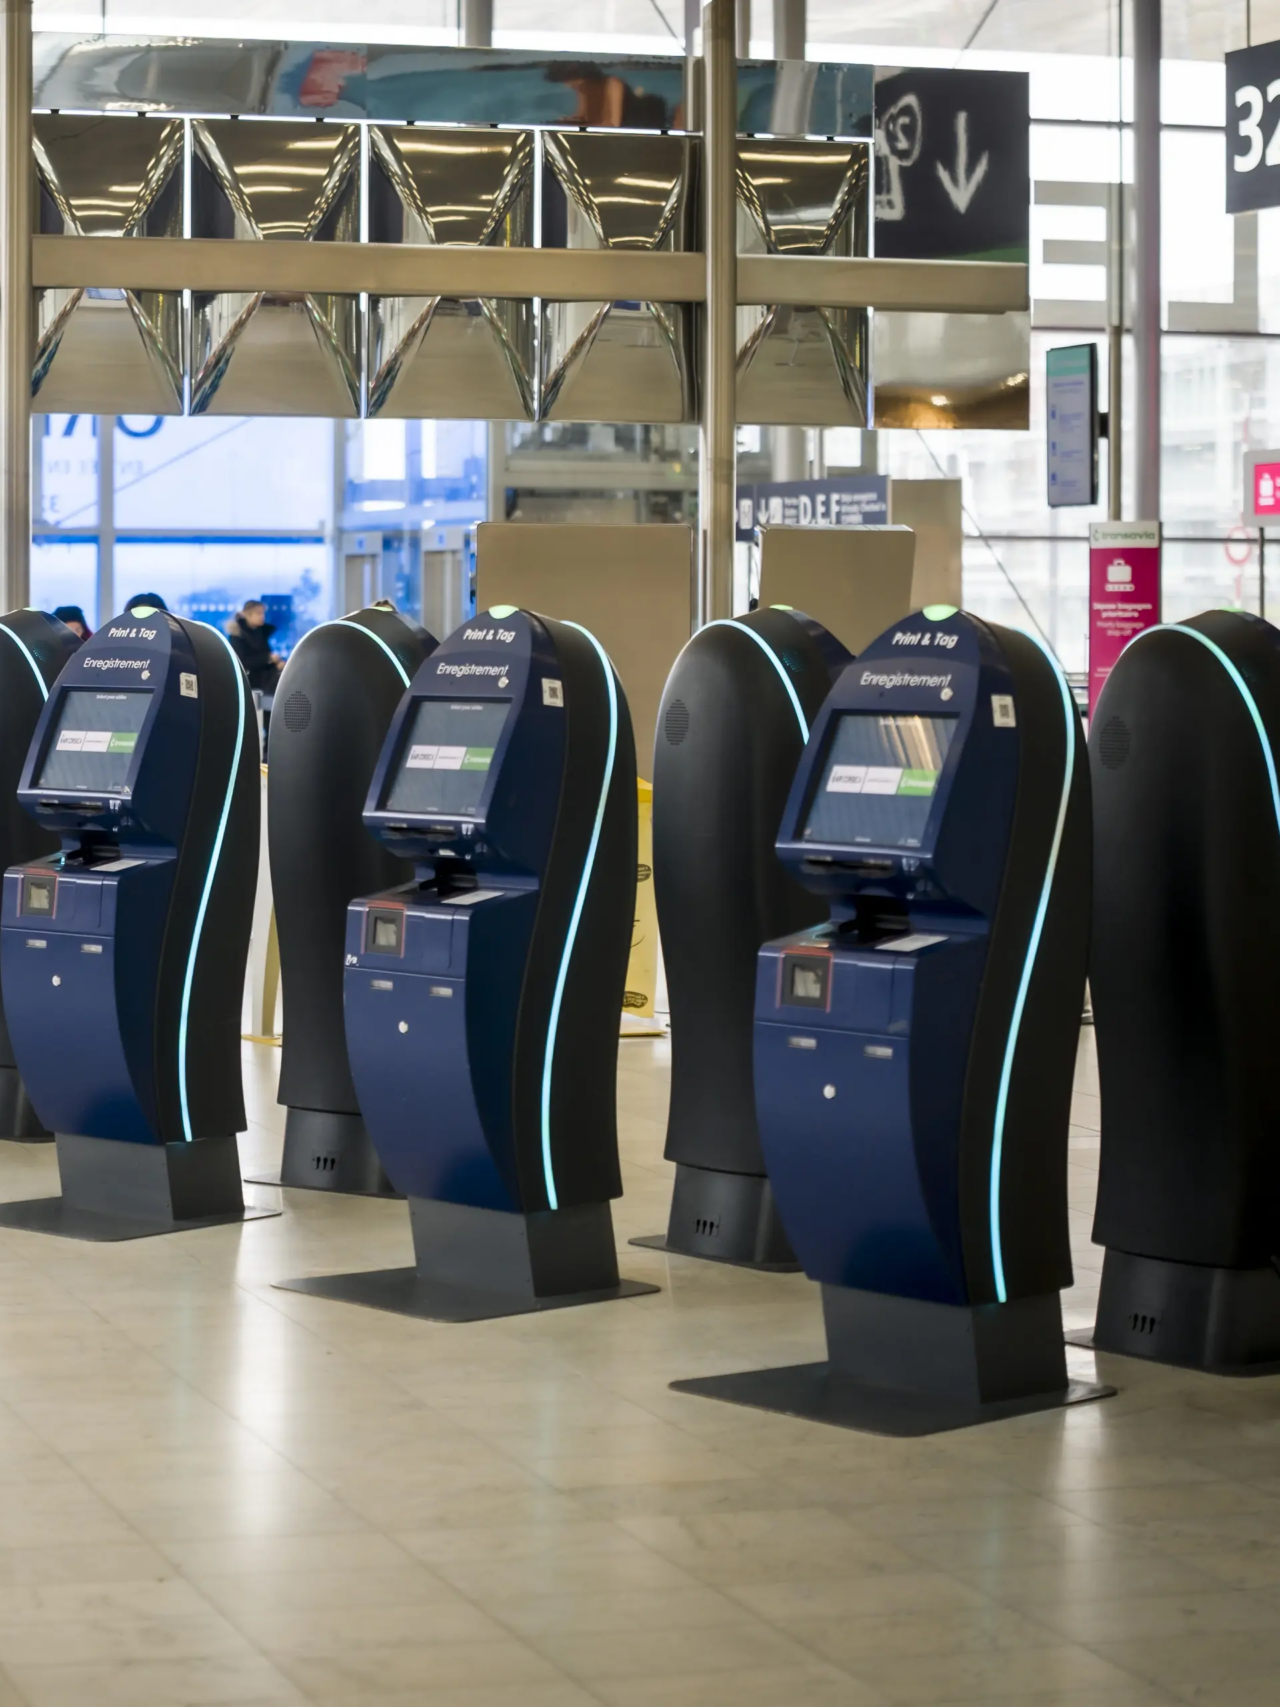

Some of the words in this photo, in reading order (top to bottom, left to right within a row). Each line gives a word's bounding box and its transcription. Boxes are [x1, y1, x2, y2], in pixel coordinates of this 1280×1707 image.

[1102, 531, 1155, 540] transavia
[108, 628, 129, 637] Print
[129, 628, 137, 637] &
[139, 628, 157, 640] Tag
[463, 629, 487, 640] Print
[486, 629, 495, 640] &
[496, 629, 516, 643] Tag
[892, 631, 921, 646] Print
[921, 632, 931, 646] &
[934, 632, 959, 649] Tag
[83, 657, 150, 670] Enregistrement
[437, 662, 509, 677] Enregistrement
[860, 671, 952, 689] Enregistrement
